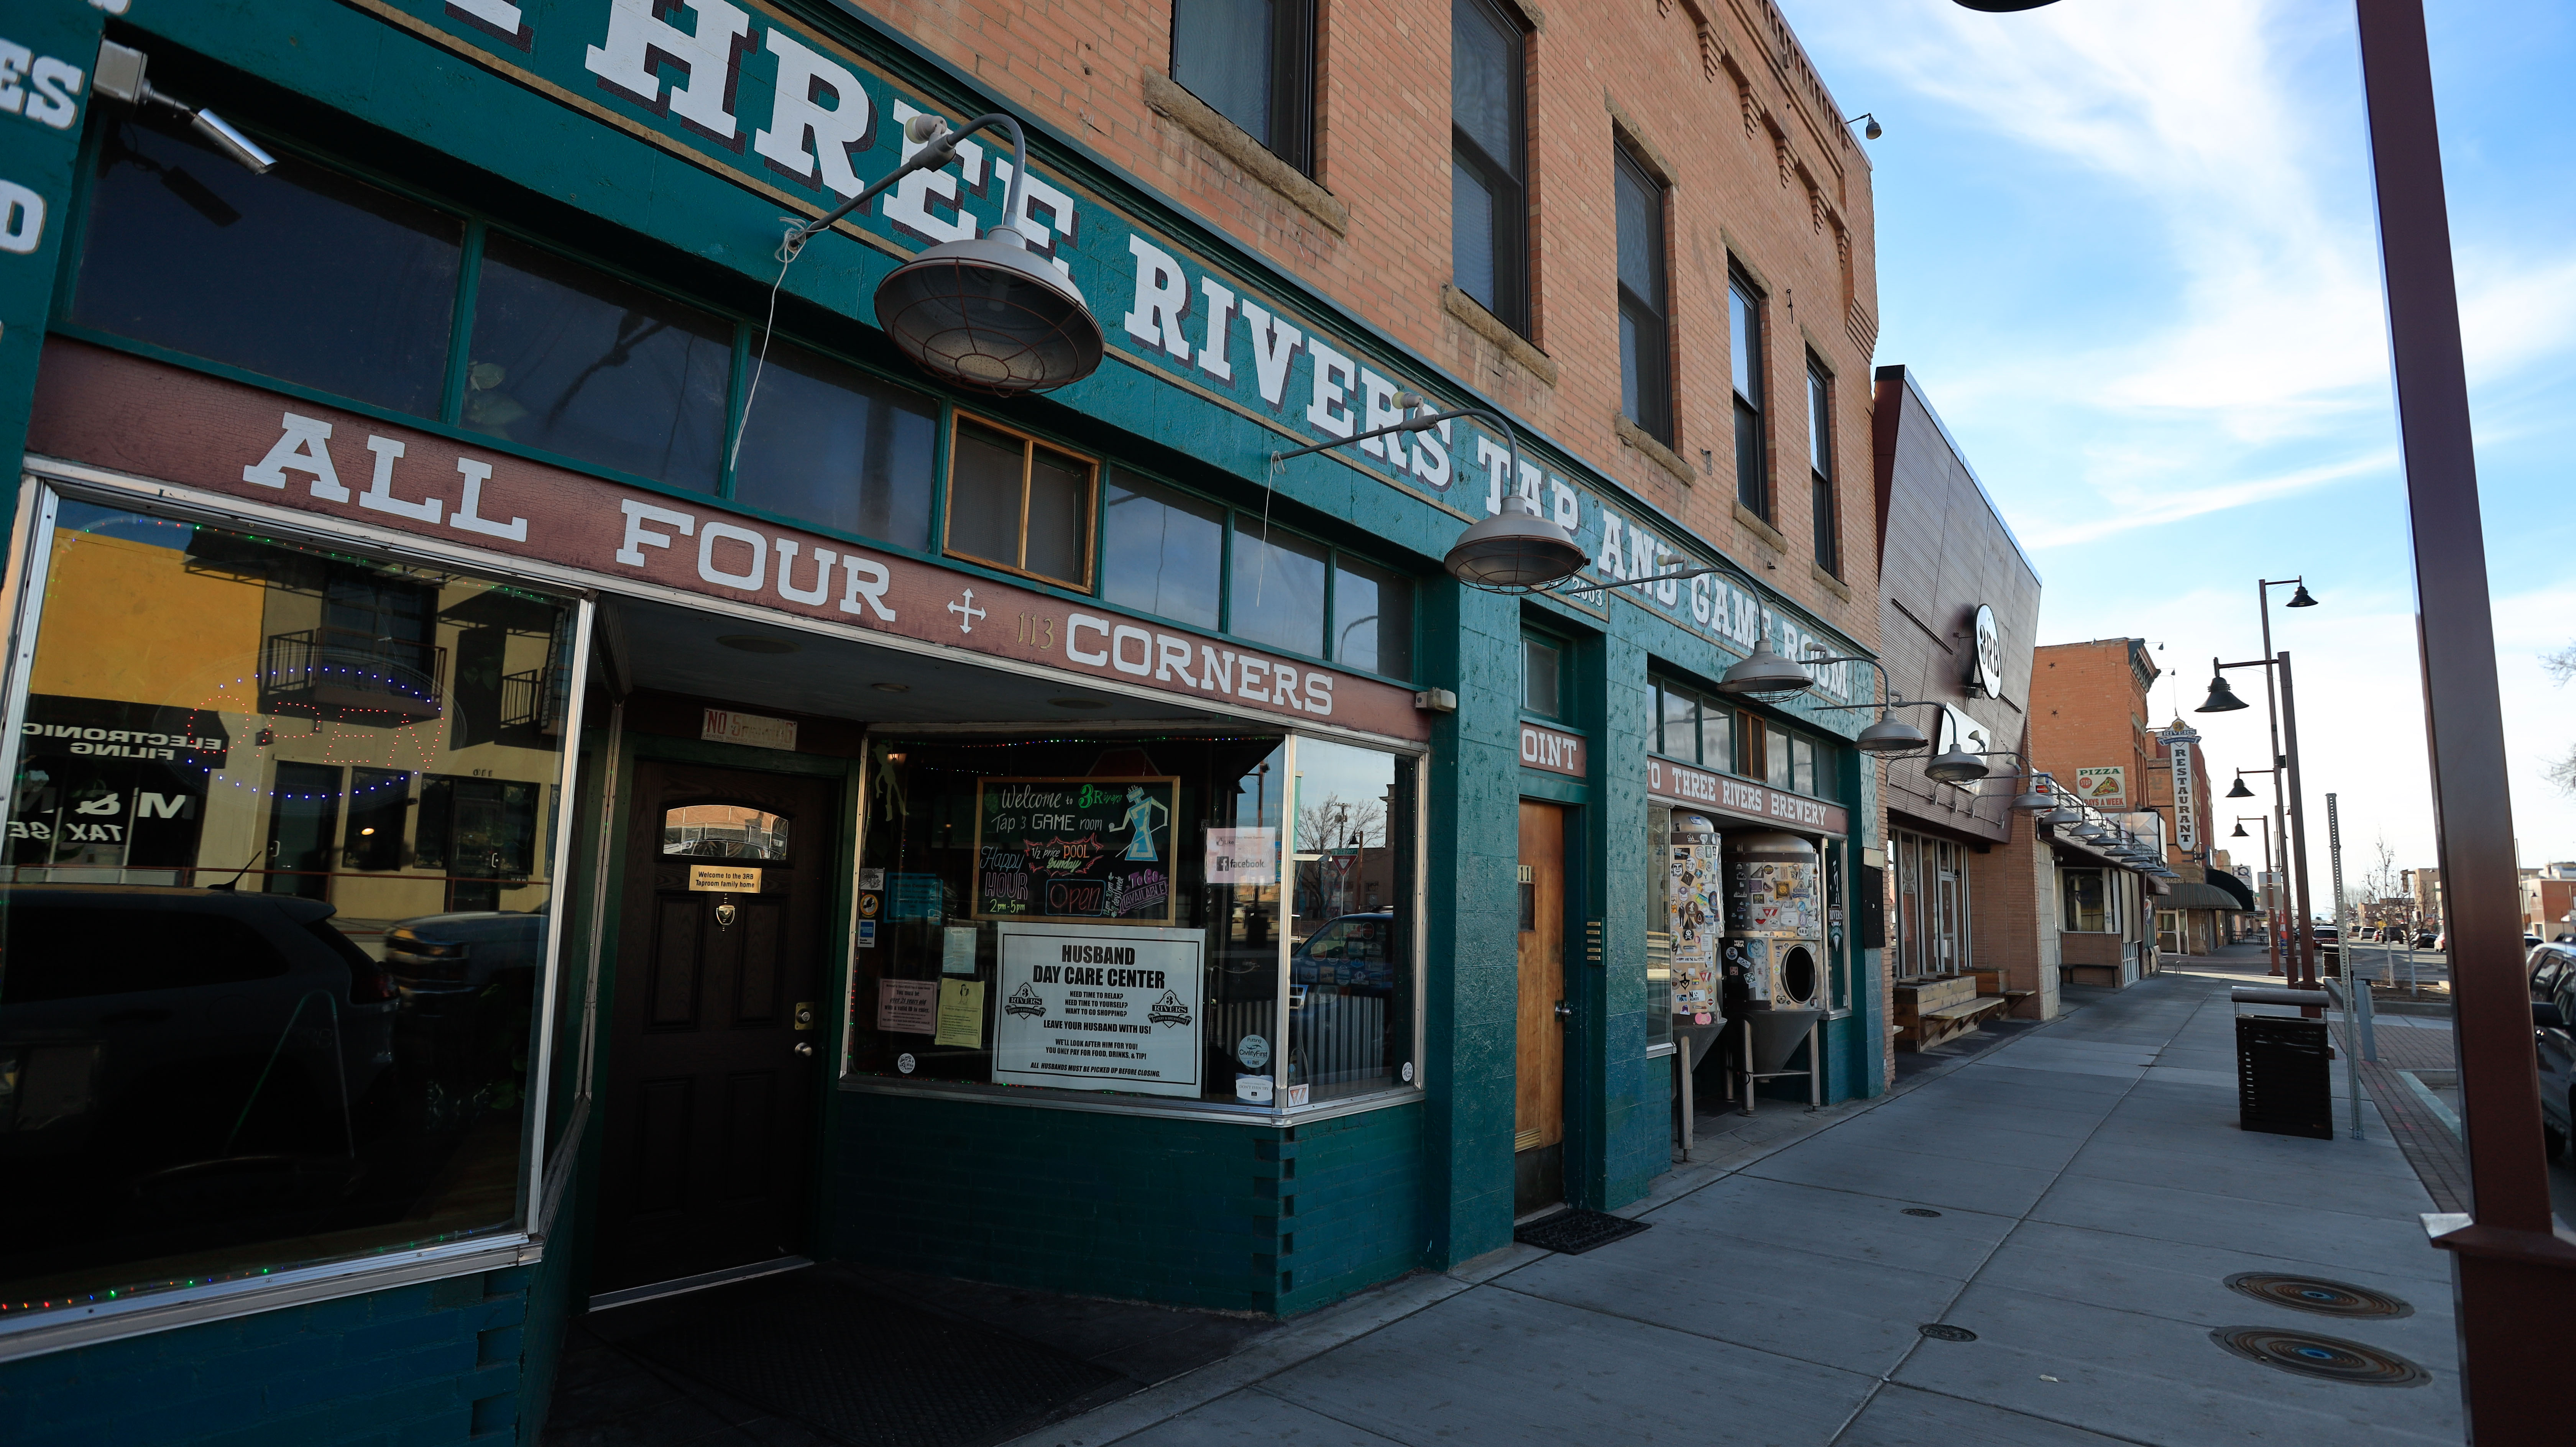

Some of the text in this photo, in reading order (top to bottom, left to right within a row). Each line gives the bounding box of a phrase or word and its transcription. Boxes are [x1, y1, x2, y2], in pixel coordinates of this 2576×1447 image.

[443, 0, 1074, 277] HREE
[1124, 233, 1452, 486] RIVERS
[1598, 514, 1677, 605] AND
[243, 412, 1333, 716] ALL FOUR CORNERS
[1017, 612, 1054, 650] 113
[1980, 625, 1999, 678] 3RB
[707, 711, 727, 734] NO
[1522, 730, 1577, 770] OINT
[1002, 784, 1061, 808] Welcome
[1066, 796, 1073, 805] to
[1672, 767, 1716, 802] THREE
[1722, 781, 1762, 813] RIVERS
[1771, 793, 1827, 827] BREWERY
[2106, 798, 2124, 806] WEEK
[2175, 750, 2191, 842] RESTAURANT
[991, 813, 1102, 833] Tap GAME room
[980, 846, 1025, 874] Happy
[1032, 846, 1040, 859] 1/2
[1043, 847, 1061, 859] price
[1046, 856, 1081, 873] Sunday
[1230, 859, 1265, 868] facebook
[985, 872, 1027, 900] HOUR
[1126, 883, 1164, 906] AVAILABLE
[1051, 884, 1101, 914] Open
[1829, 910, 1843, 920] RIVERS
[1061, 945, 1135, 965] HUSBAND
[1033, 965, 1165, 989] DAY CARE CENTER
[1022, 988, 1028, 997] 3
[1166, 996, 1173, 1005] 3
[1044, 1020, 1151, 1034] LEAVE YOUR HUSBAND WITH US!
[1092, 1049, 1107, 1057] FOOD,
[1125, 1042, 1138, 1050] YOU!
[1239, 1049, 1267, 1058] CivilityFirst
[1041, 1063, 1067, 1071] HUSBANDS
[1119, 1067, 1136, 1075] BEFORE
[1138, 1069, 1161, 1077] CLOSING.
